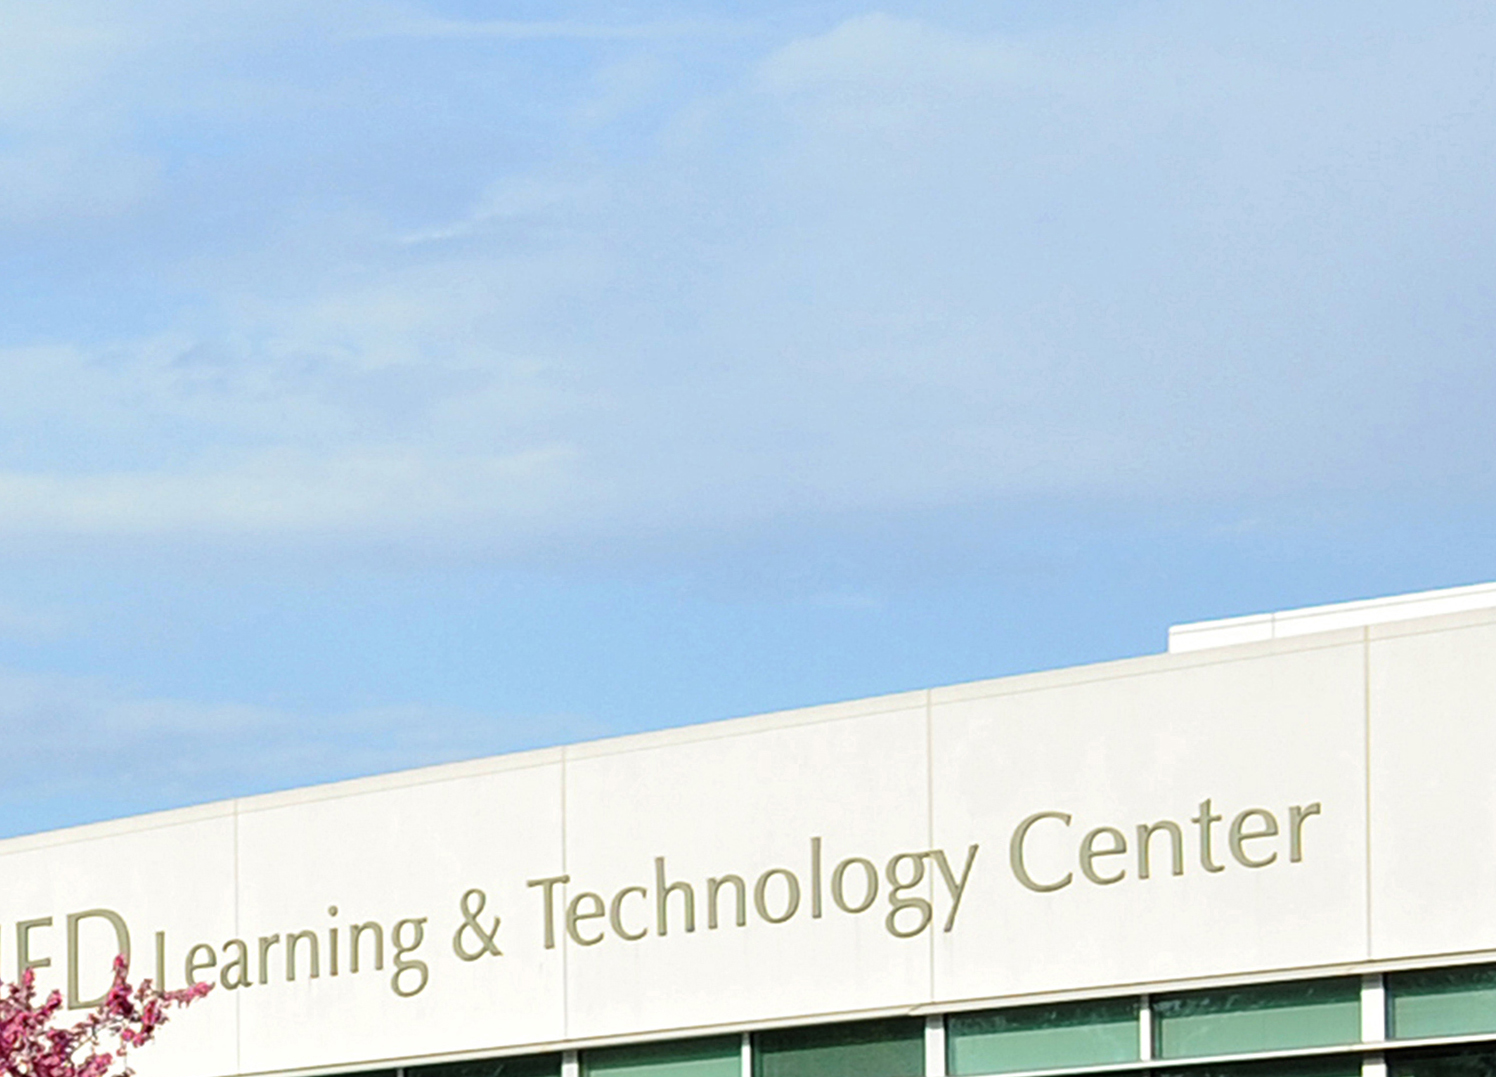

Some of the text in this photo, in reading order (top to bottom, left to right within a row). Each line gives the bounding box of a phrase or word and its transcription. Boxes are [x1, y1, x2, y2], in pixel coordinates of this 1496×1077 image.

[155, 904, 430, 998] Learning
[452, 887, 504, 962] &
[527, 835, 979, 950] Technology
[1008, 797, 1321, 894] Center
